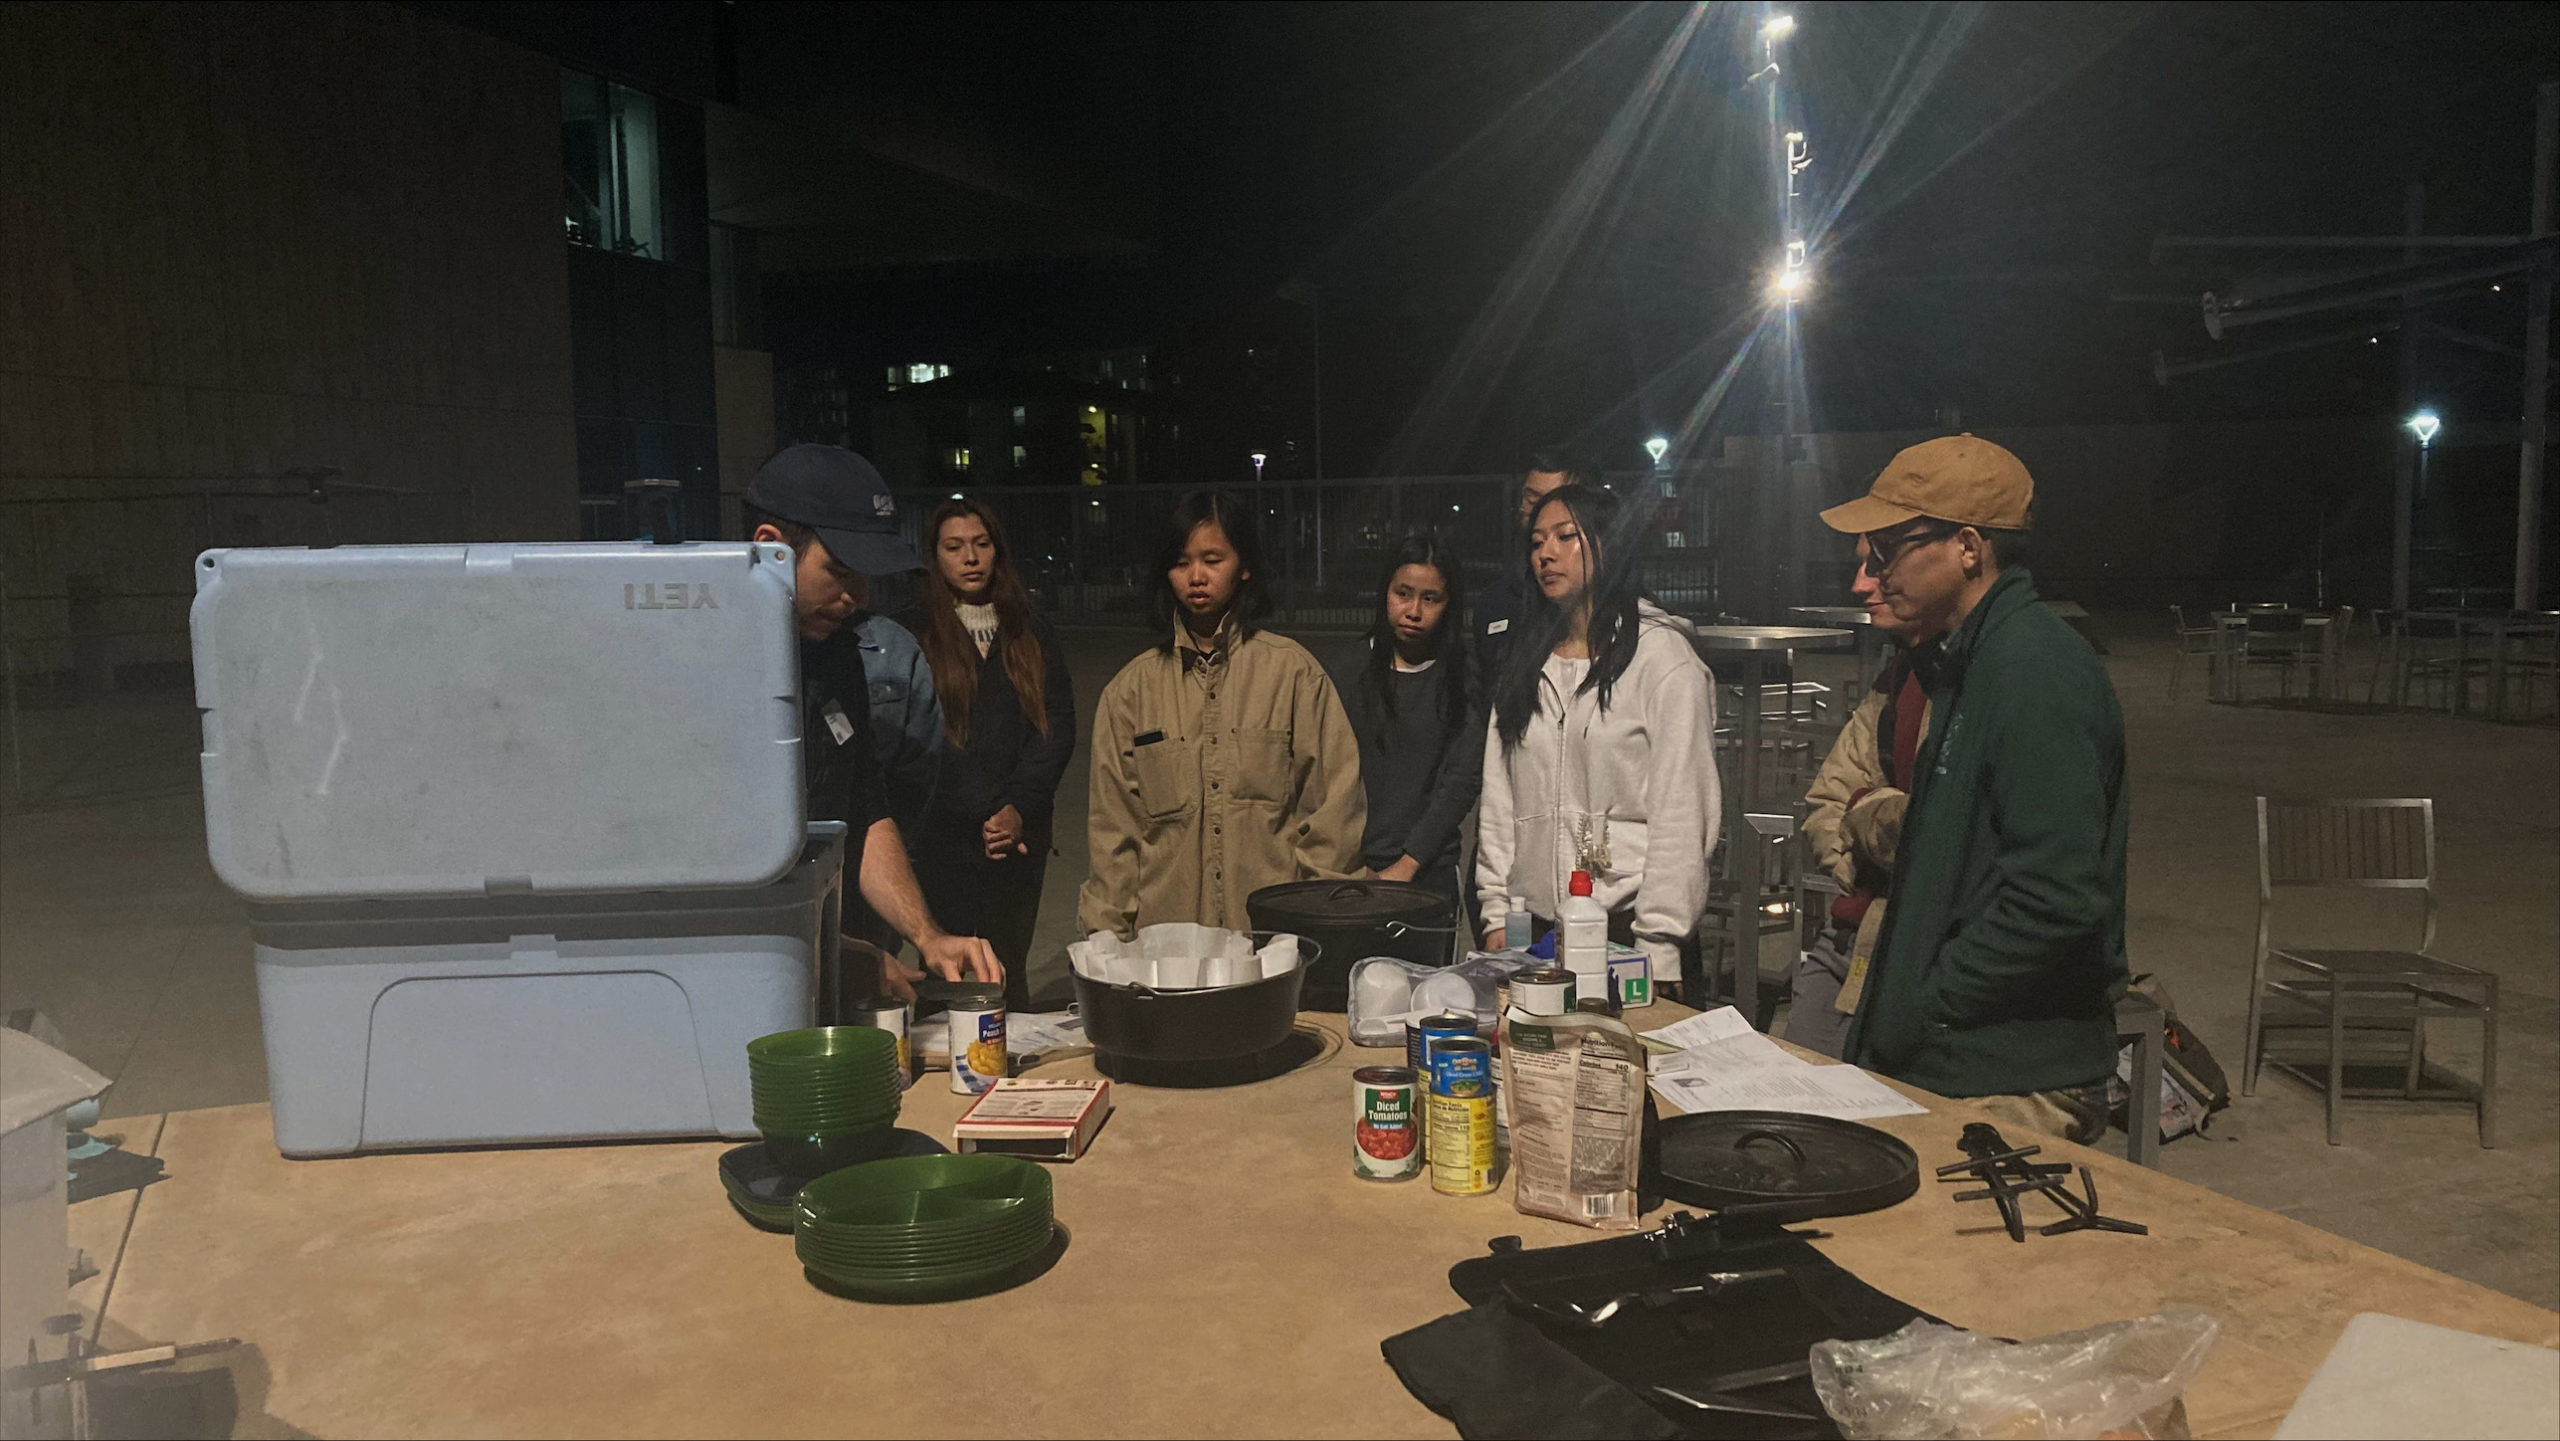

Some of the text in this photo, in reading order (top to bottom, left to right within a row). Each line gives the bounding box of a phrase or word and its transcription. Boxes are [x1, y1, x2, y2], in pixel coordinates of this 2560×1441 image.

[624, 582, 720, 610] YETI
[1632, 981, 1642, 996] L
[1376, 1101, 1400, 1111] Diced
[1368, 1110, 1408, 1121] Tomatoes
